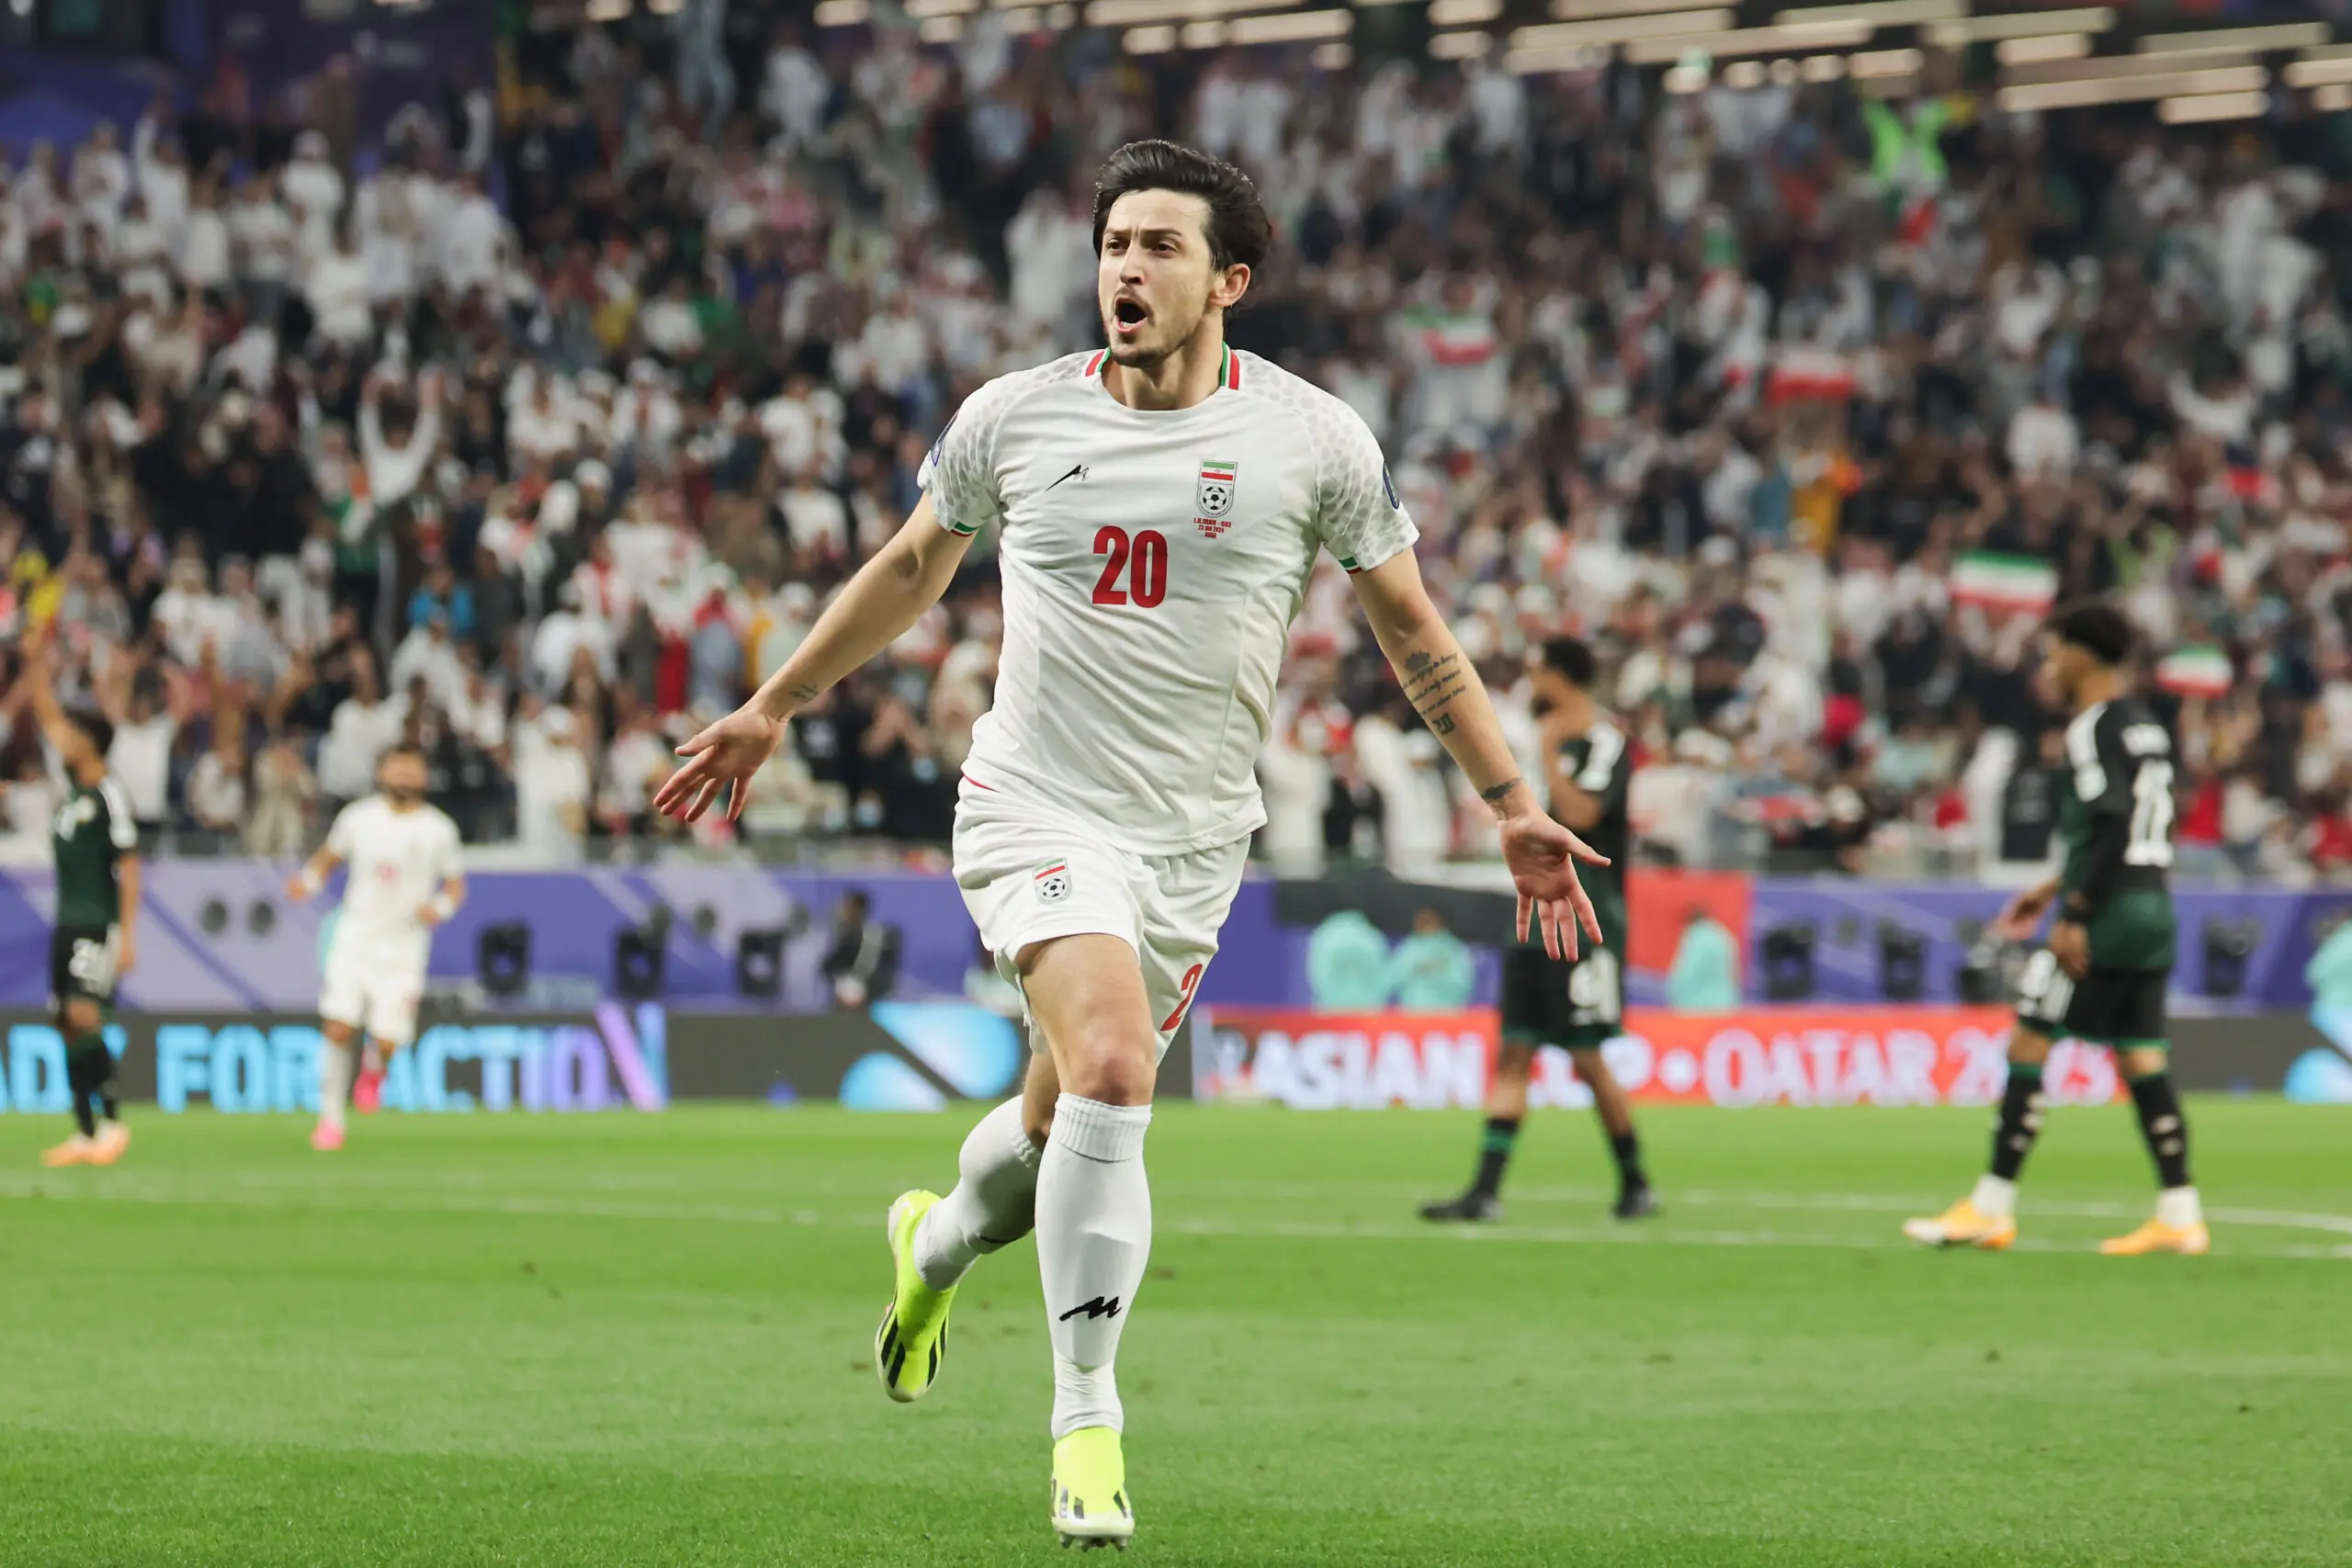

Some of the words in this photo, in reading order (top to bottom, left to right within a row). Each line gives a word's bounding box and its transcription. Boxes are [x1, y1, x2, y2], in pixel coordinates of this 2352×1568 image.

[1091, 525, 1168, 609] 20
[155, 1023, 323, 1114] FOR
[1252, 1028, 1487, 1109] ASIAN
[1702, 1027, 1941, 1108] QATAR
